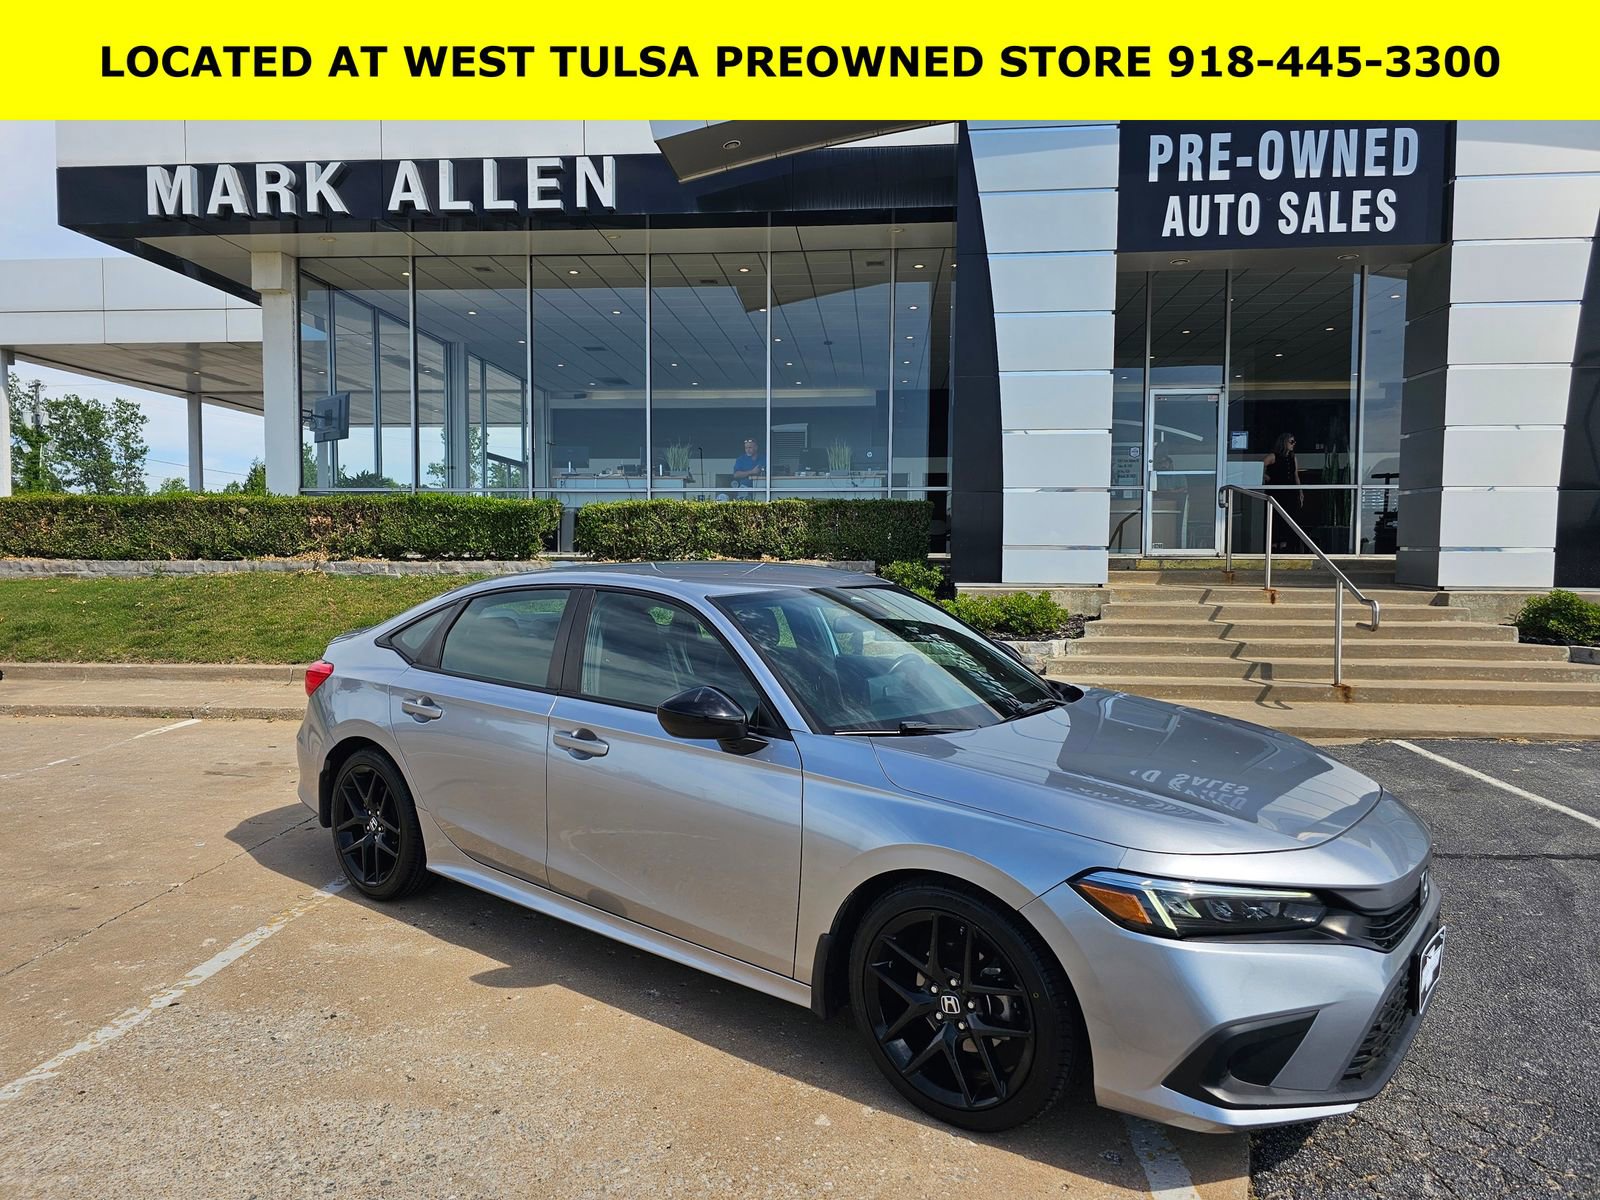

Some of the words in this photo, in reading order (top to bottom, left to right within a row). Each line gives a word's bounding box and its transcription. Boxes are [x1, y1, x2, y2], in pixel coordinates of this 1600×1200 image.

[1148, 127, 1419, 182] PRE-OWNED
[146, 163, 349, 217] MARK
[388, 155, 616, 214] ALLEN
[1161, 192, 1261, 237] AUTO
[1277, 188, 1397, 235] SALES
